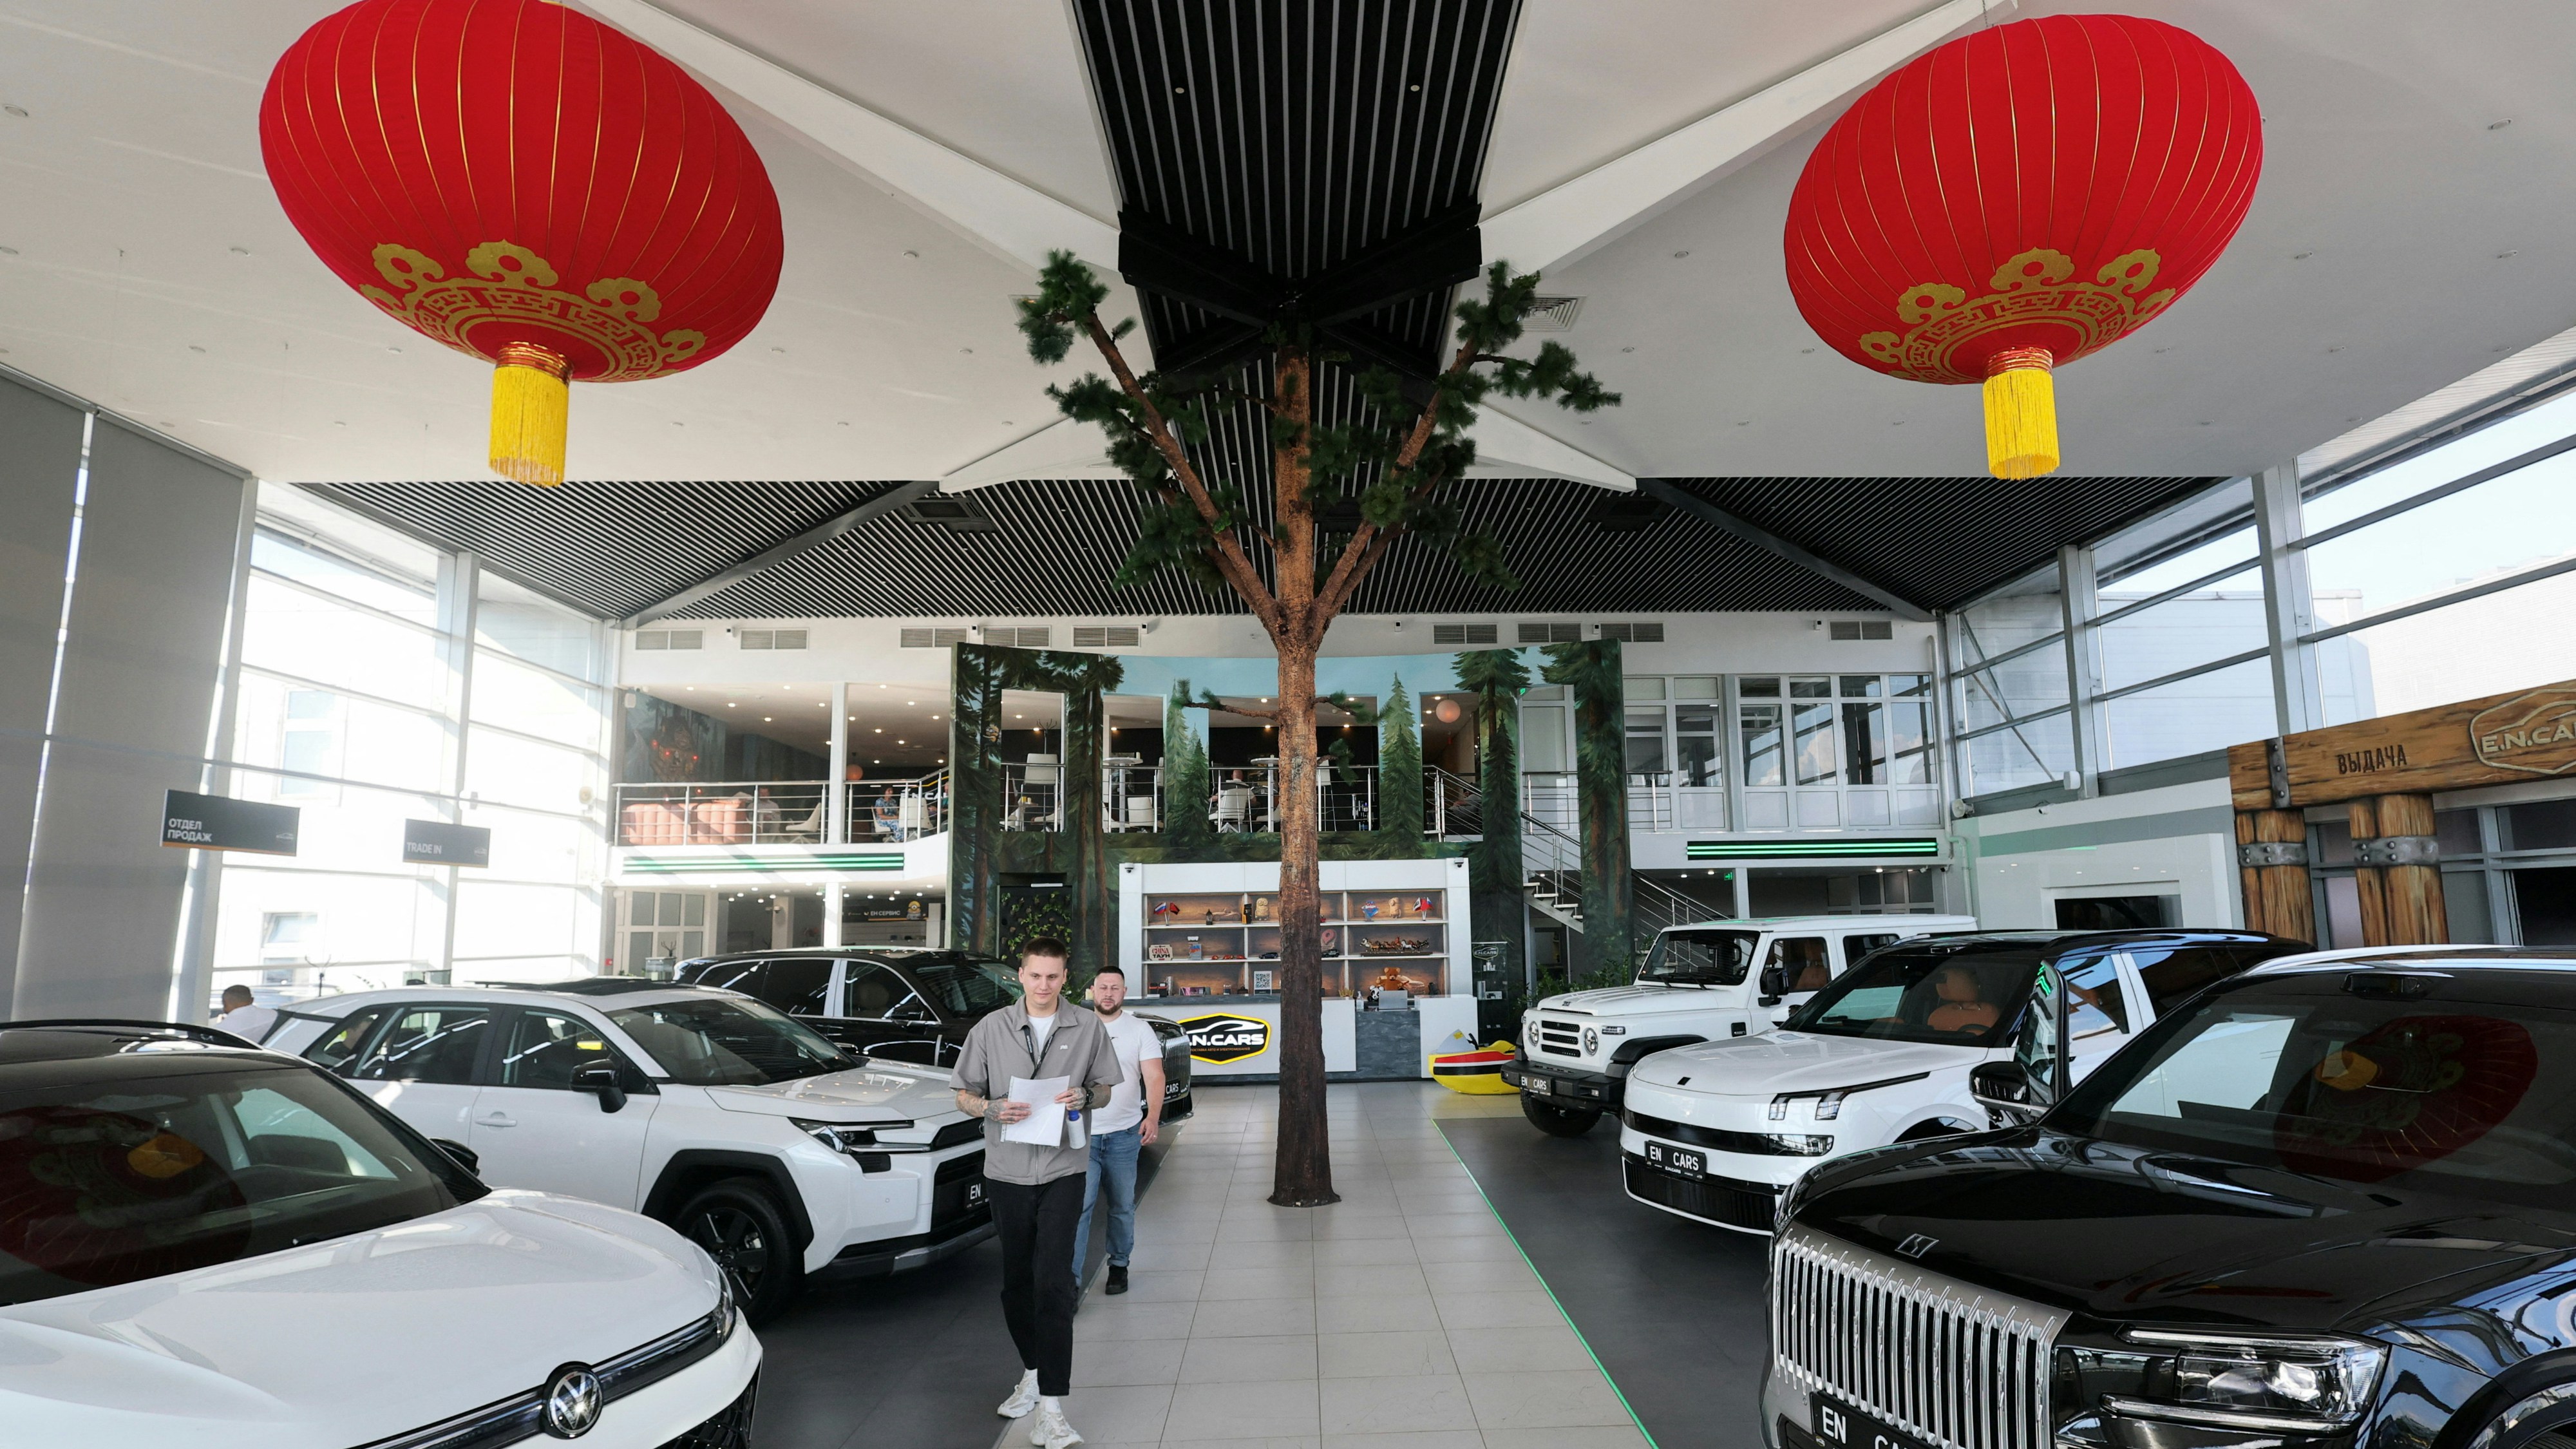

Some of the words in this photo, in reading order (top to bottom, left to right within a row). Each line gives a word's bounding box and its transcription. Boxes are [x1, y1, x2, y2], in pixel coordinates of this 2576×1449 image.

[2481, 721, 2576, 753] E.N.CA
[2336, 744, 2407, 774] ВЫДАЧА
[169, 818, 202, 830] ОТДЕЛ
[167, 829, 212, 842] ПРОДАЖ
[406, 842, 433, 853] TRADE
[433, 844, 442, 855] IN
[1189, 1033, 1264, 1046] .N.CARS
[1166, 1083, 1179, 1094] CARS
[1521, 1076, 1528, 1086] EN
[1533, 1079, 1547, 1090] CARS
[1650, 1146, 1662, 1161] EN
[1673, 1152, 1699, 1171] CARS
[970, 1183, 981, 1200] EN
[1822, 1405, 1846, 1444] EN
